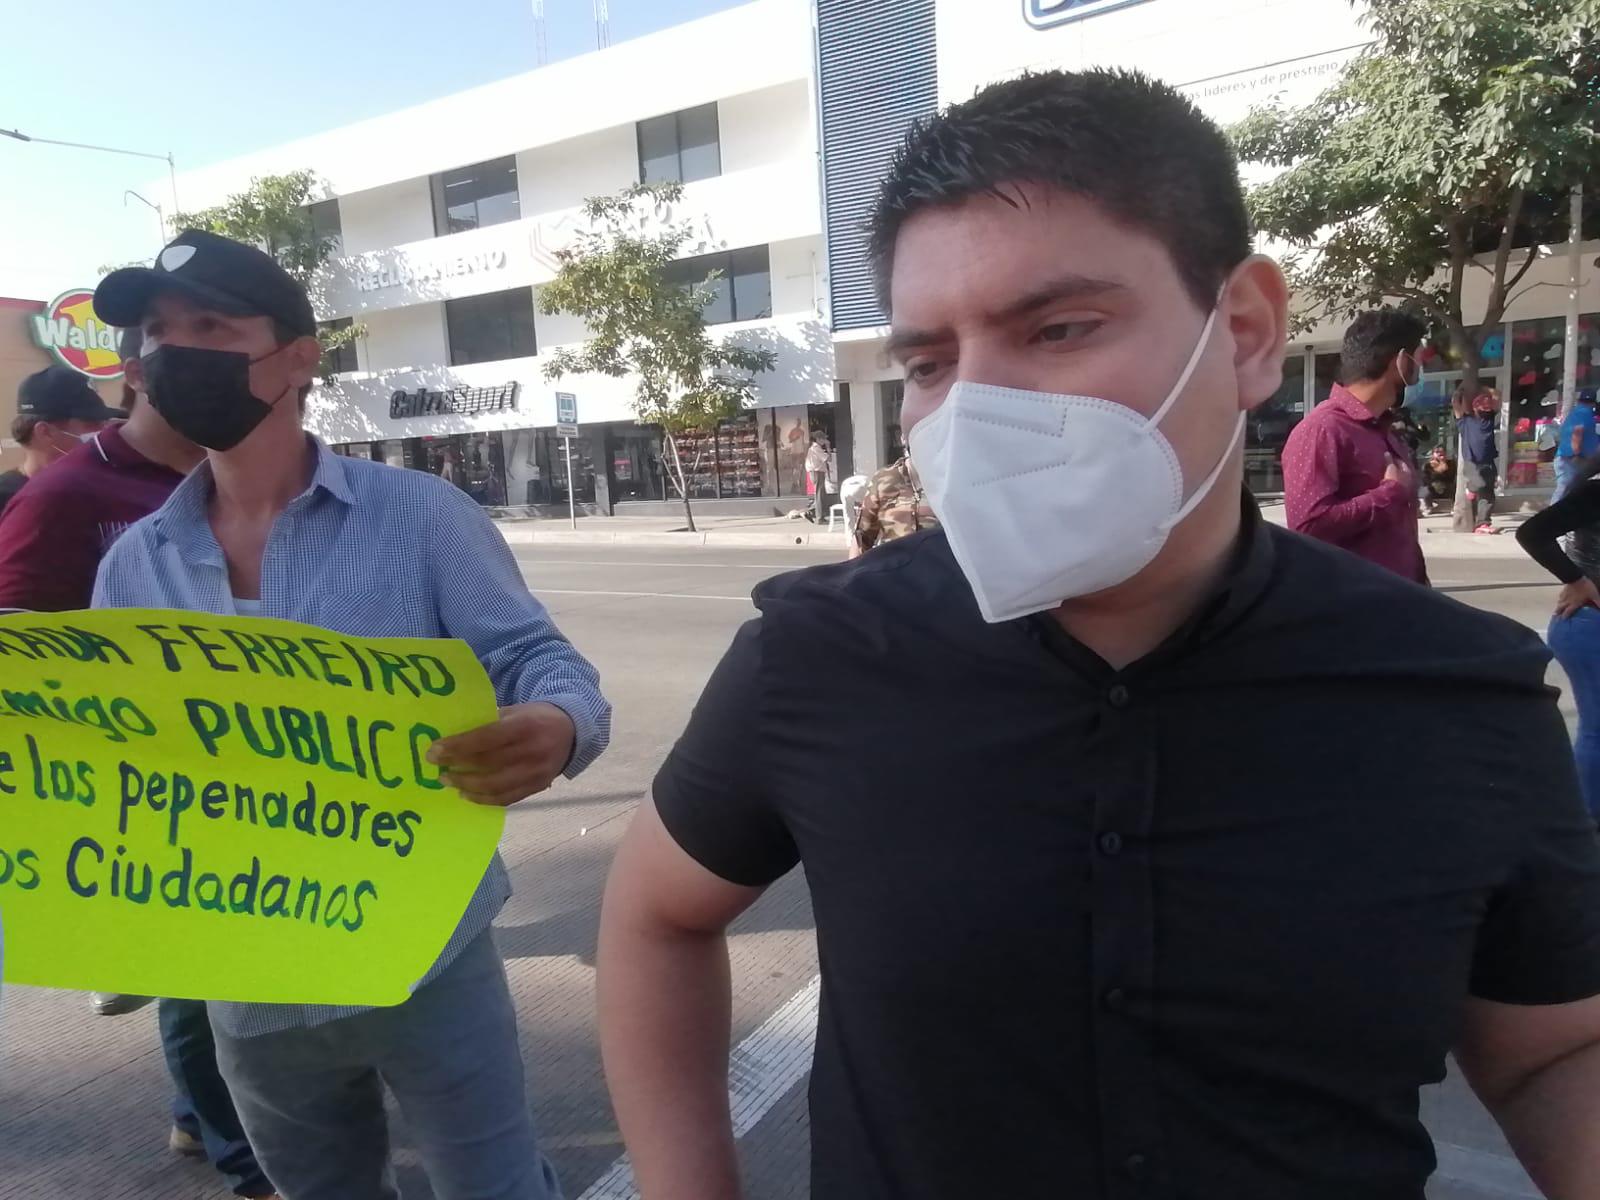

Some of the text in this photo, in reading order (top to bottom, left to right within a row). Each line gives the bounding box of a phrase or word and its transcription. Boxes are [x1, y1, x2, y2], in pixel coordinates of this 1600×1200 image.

[1260, 74, 1276, 86] de
[1279, 61, 1339, 83] prestigio
[136, 624, 456, 698] FERREIRO
[184, 697, 447, 790] PUBLICO
[26, 733, 96, 807] los
[118, 760, 422, 857] pepenadores
[66, 836, 378, 931] Ciudadanos
